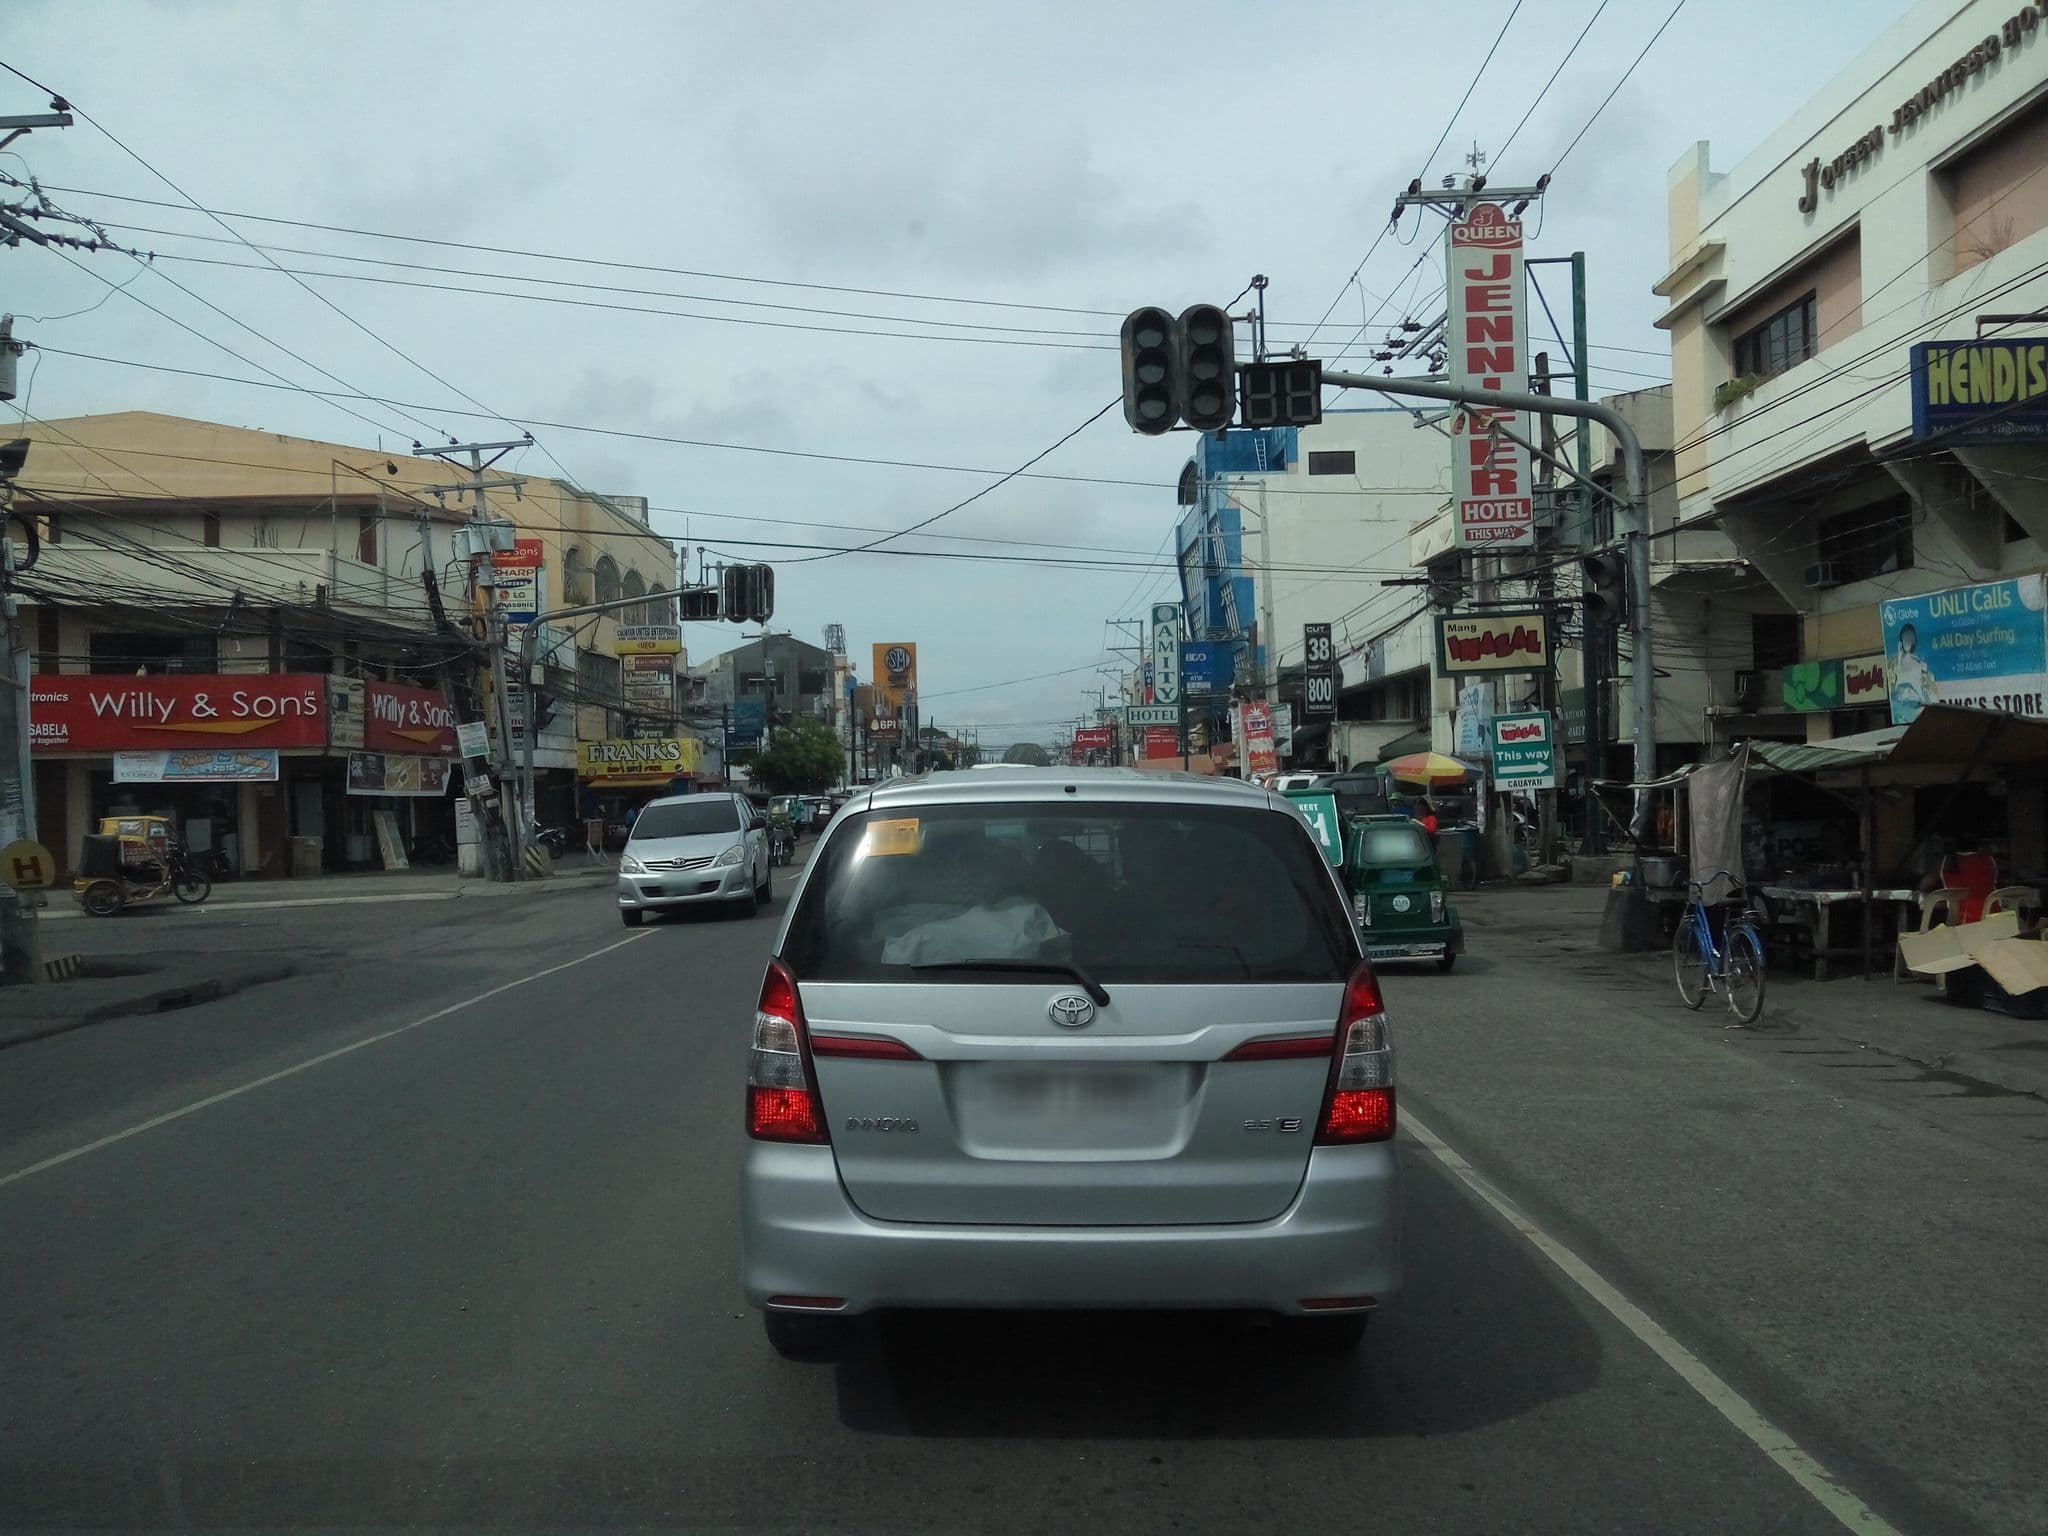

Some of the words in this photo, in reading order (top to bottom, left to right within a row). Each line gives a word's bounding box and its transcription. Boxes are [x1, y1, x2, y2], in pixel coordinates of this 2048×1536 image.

[1454, 225, 1520, 242] QUEEN
[1465, 501, 1528, 521] HOTEL
[1470, 528, 1491, 540] THIS
[1493, 527, 1516, 540] WAY
[1929, 592, 1968, 618] UNLI
[1972, 586, 2012, 610] Calls
[1447, 624, 1477, 633] Mang
[1308, 637, 1330, 662] 38
[1158, 625, 1175, 700] AMITY
[1308, 677, 1332, 703] 800
[89, 691, 176, 723] Willy
[192, 693, 219, 717] &
[232, 691, 317, 718] Sons
[373, 693, 405, 728] Willy
[409, 700, 421, 725] &
[423, 701, 455, 728] Sons
[1993, 693, 2044, 715] STORE
[880, 719, 896, 729] BPI
[1130, 710, 1177, 721] HOTEL
[1496, 751, 1522, 761] This
[1526, 750, 1550, 760] way
[1508, 779, 1542, 788] CAUAYAN
[12, 855, 43, 880] H
